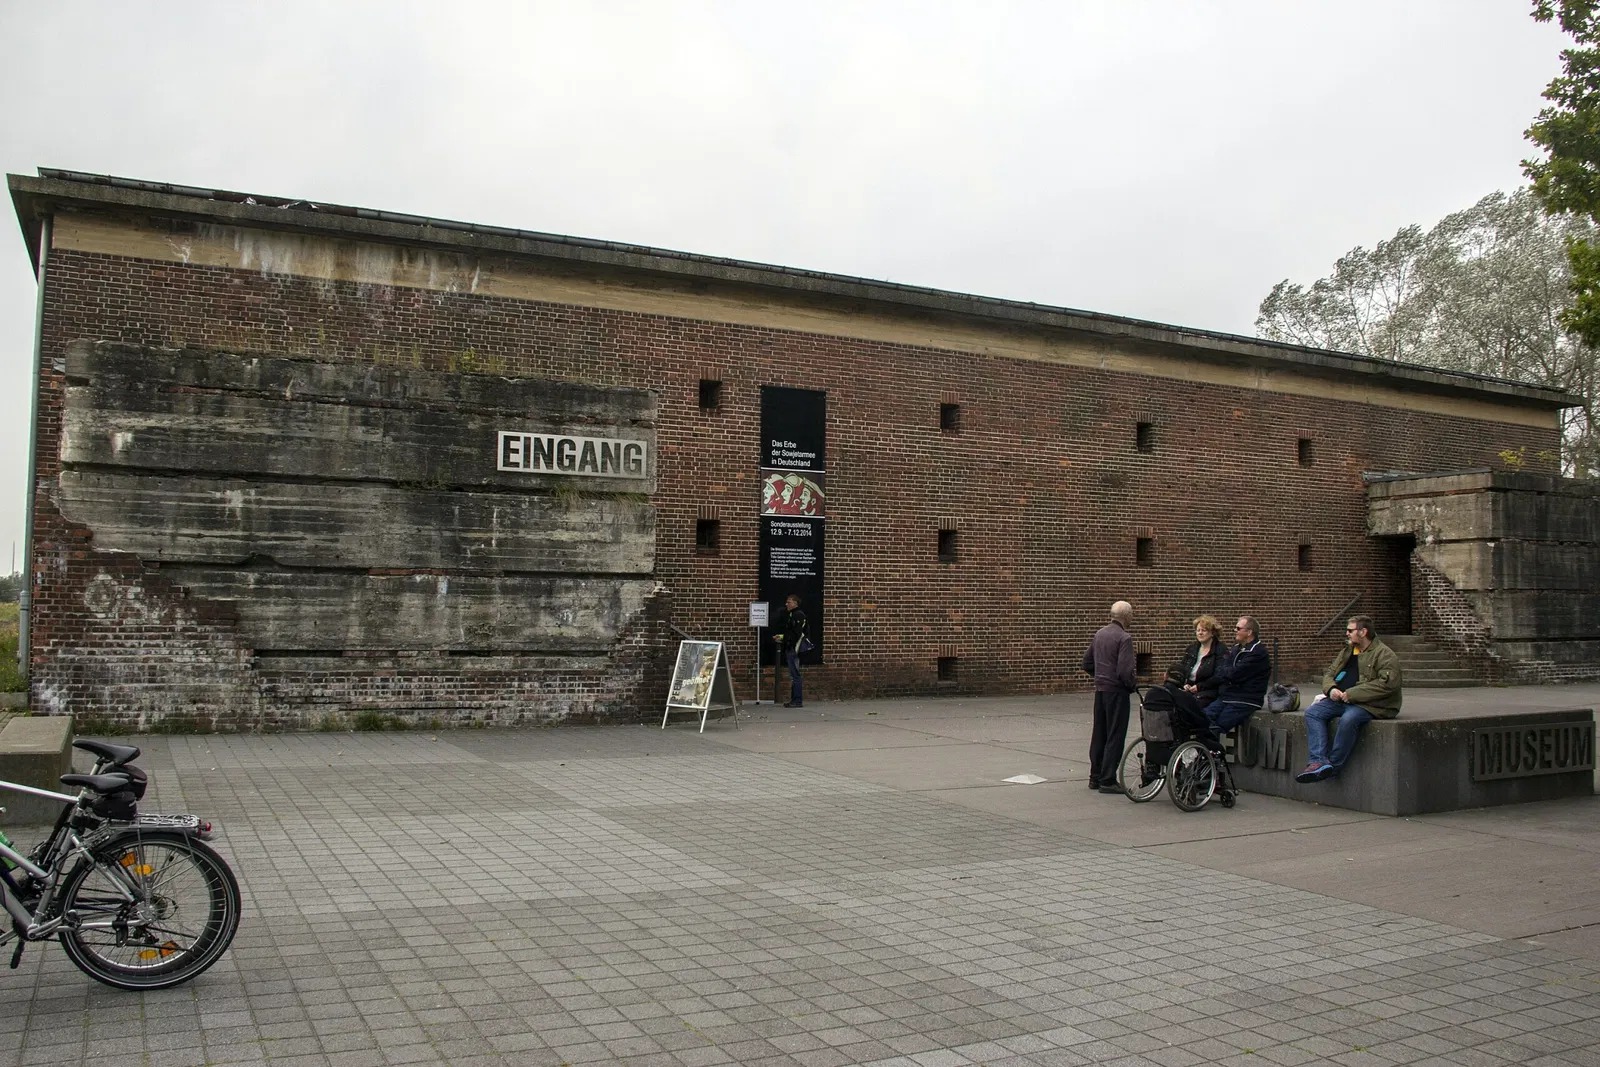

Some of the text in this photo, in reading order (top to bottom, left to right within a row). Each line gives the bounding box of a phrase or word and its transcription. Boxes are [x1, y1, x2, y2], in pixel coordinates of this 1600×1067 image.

[771, 440, 783, 448] Das
[503, 434, 642, 475] EINGANG
[782, 450, 816, 458] Sowjetarmee
[778, 458, 811, 467] Deutschland
[771, 521, 812, 529] Sonderausstellung
[788, 529, 812, 537] 7.12.2014
[1480, 726, 1592, 775] MUSEUM
